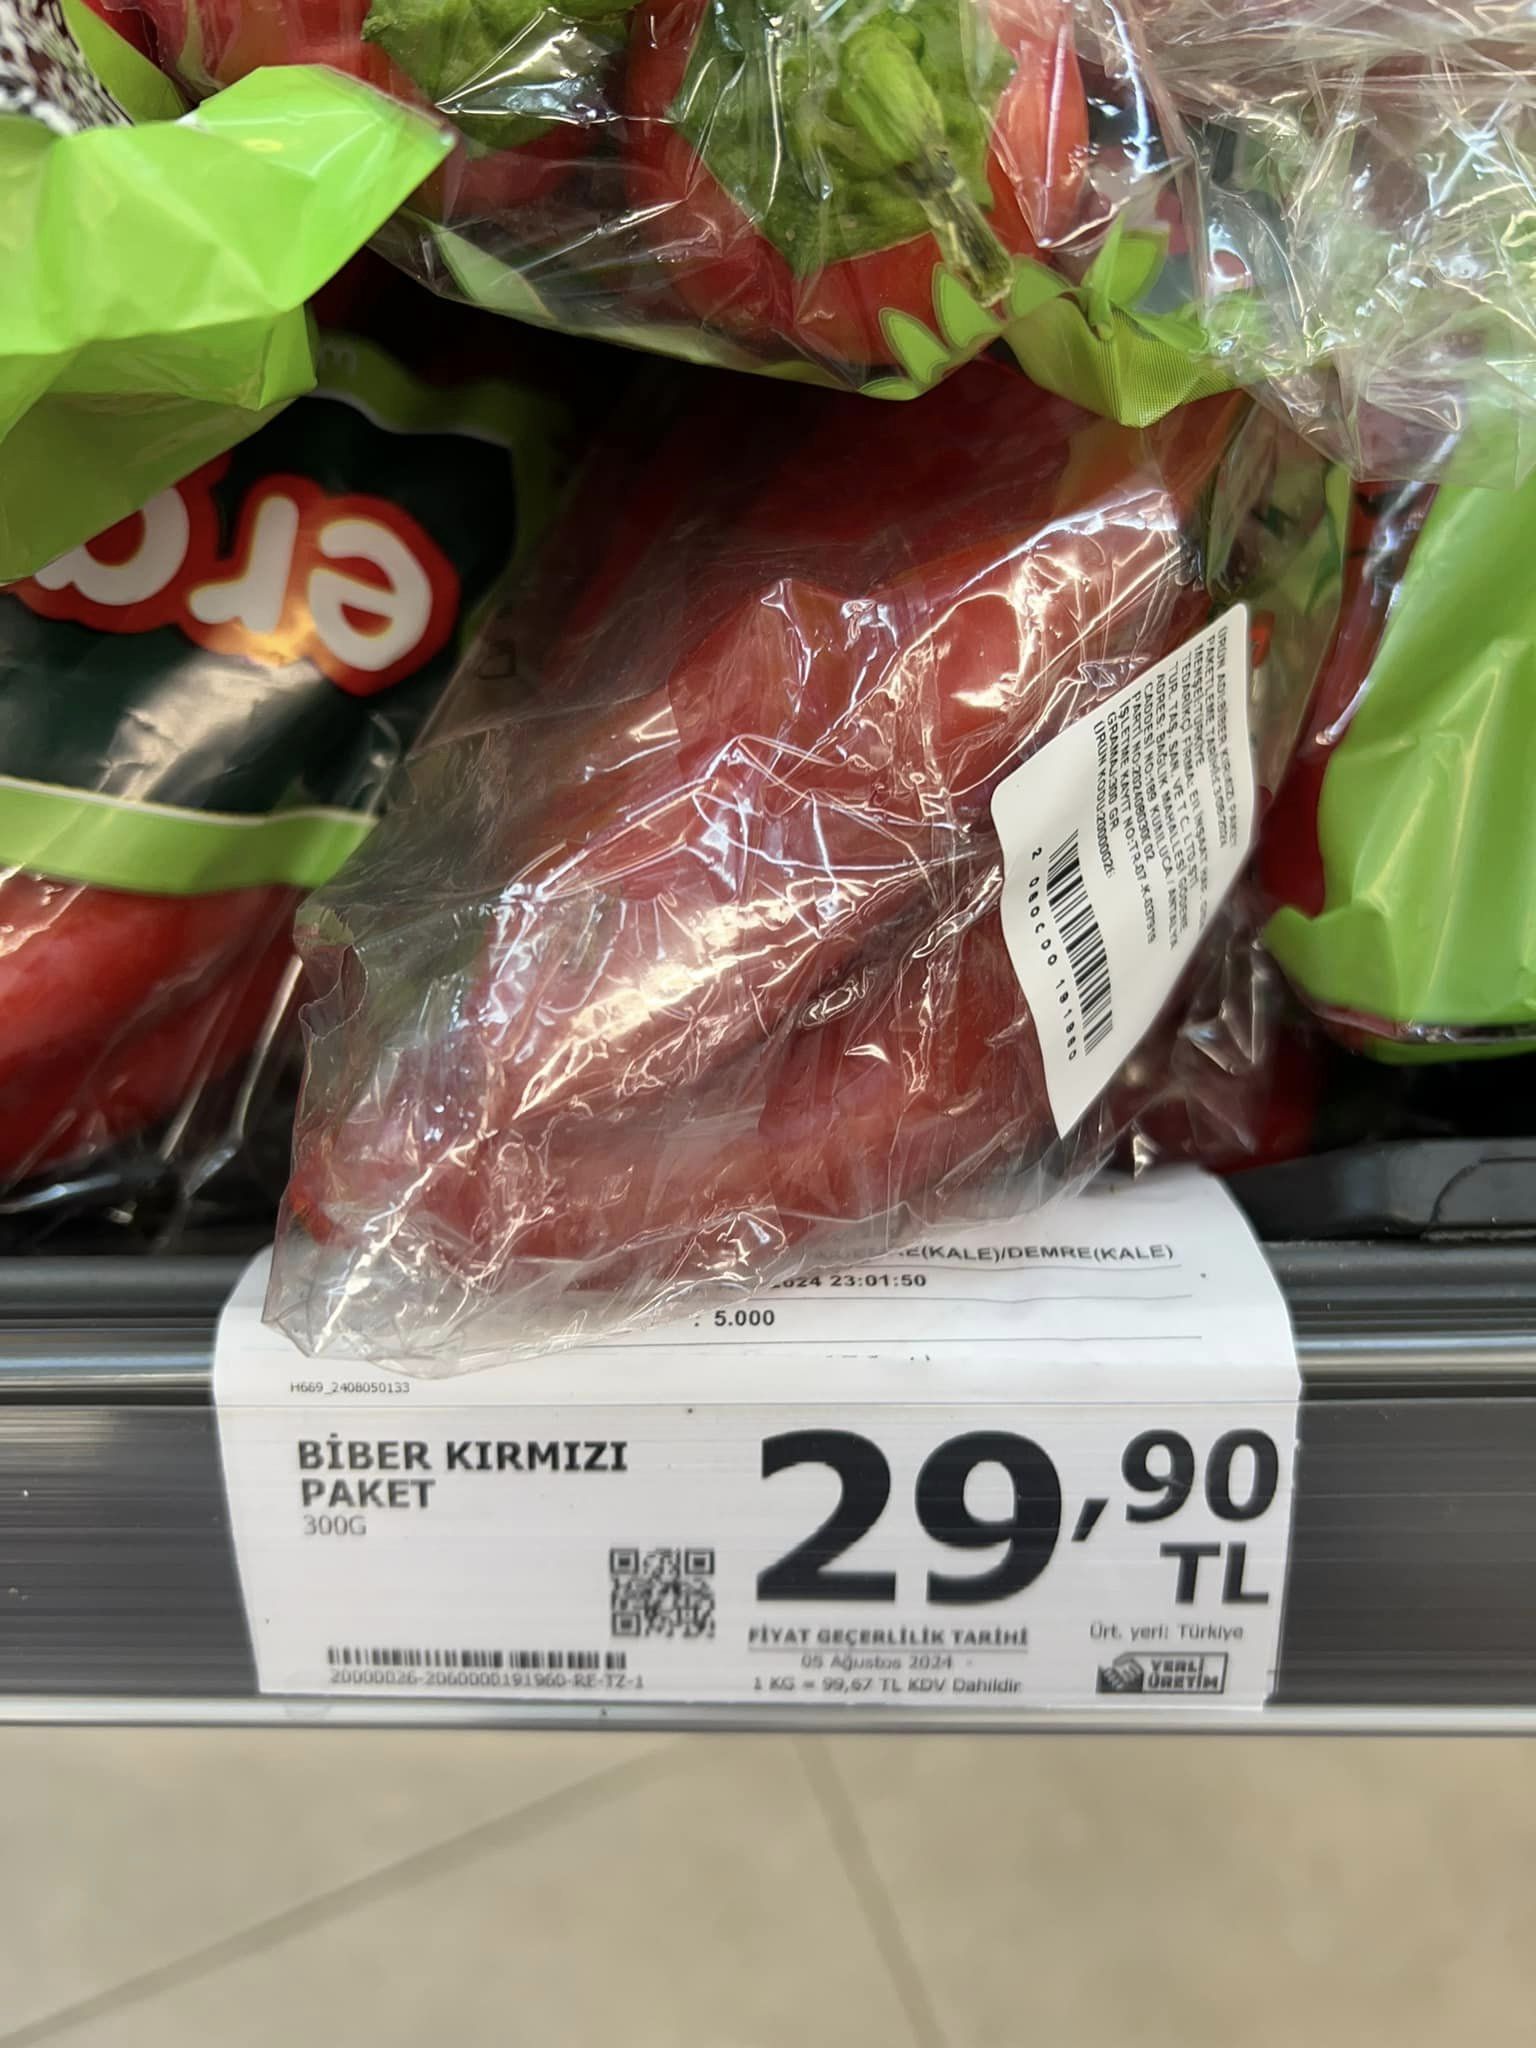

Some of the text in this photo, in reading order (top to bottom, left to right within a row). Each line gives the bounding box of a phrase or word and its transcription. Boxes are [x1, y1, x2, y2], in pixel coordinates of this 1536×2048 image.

[1156, 670, 1165, 730] ADRES:
[1182, 650, 1191, 734] TEDARİKÇİ
[1206, 633, 1214, 725] PAKETLEME
[1119, 698, 1130, 768] İŞLETME
[1131, 689, 1142, 740] PARTİ
[1144, 680, 1154, 751] CADDESİ
[1106, 709, 1119, 833] GRAMAJ:300 GR
[1144, 750, 1157, 804] NO:189
[1155, 730, 1168, 789] BAĞLIK
[1120, 768, 1131, 816] KAYIT
[1172, 776, 1183, 802] VE
[1032, 848, 1042, 860] 2
[1161, 789, 1186, 875] MAHALLESİ
[1168, 886, 1177, 950] ANTALYA
[898, 1244, 1174, 1262] E(KALE)/DEMRE(KALE)
[830, 1273, 926, 1288] 23:01:50
[714, 1310, 775, 1327] 5.000
[297, 1433, 628, 1472] BİBER KIRMIZI
[301, 1478, 436, 1508] PAKET
[303, 1514, 366, 1536] 300G
[1160, 1541, 1269, 1606] TL
[749, 1625, 1029, 1647] FİYAT GEÇERLİLİK TARİHİ
[1177, 1622, 1244, 1641] Türkiye
[769, 1676, 795, 1692] KG
[821, 1677, 873, 1694] 99,67
[879, 1678, 901, 1693] TL
[908, 1678, 947, 1693] KDV
[952, 1677, 1023, 1693] Dahildir
[831, 1655, 902, 1672] Ağustos
[908, 1655, 953, 1670] 2024
